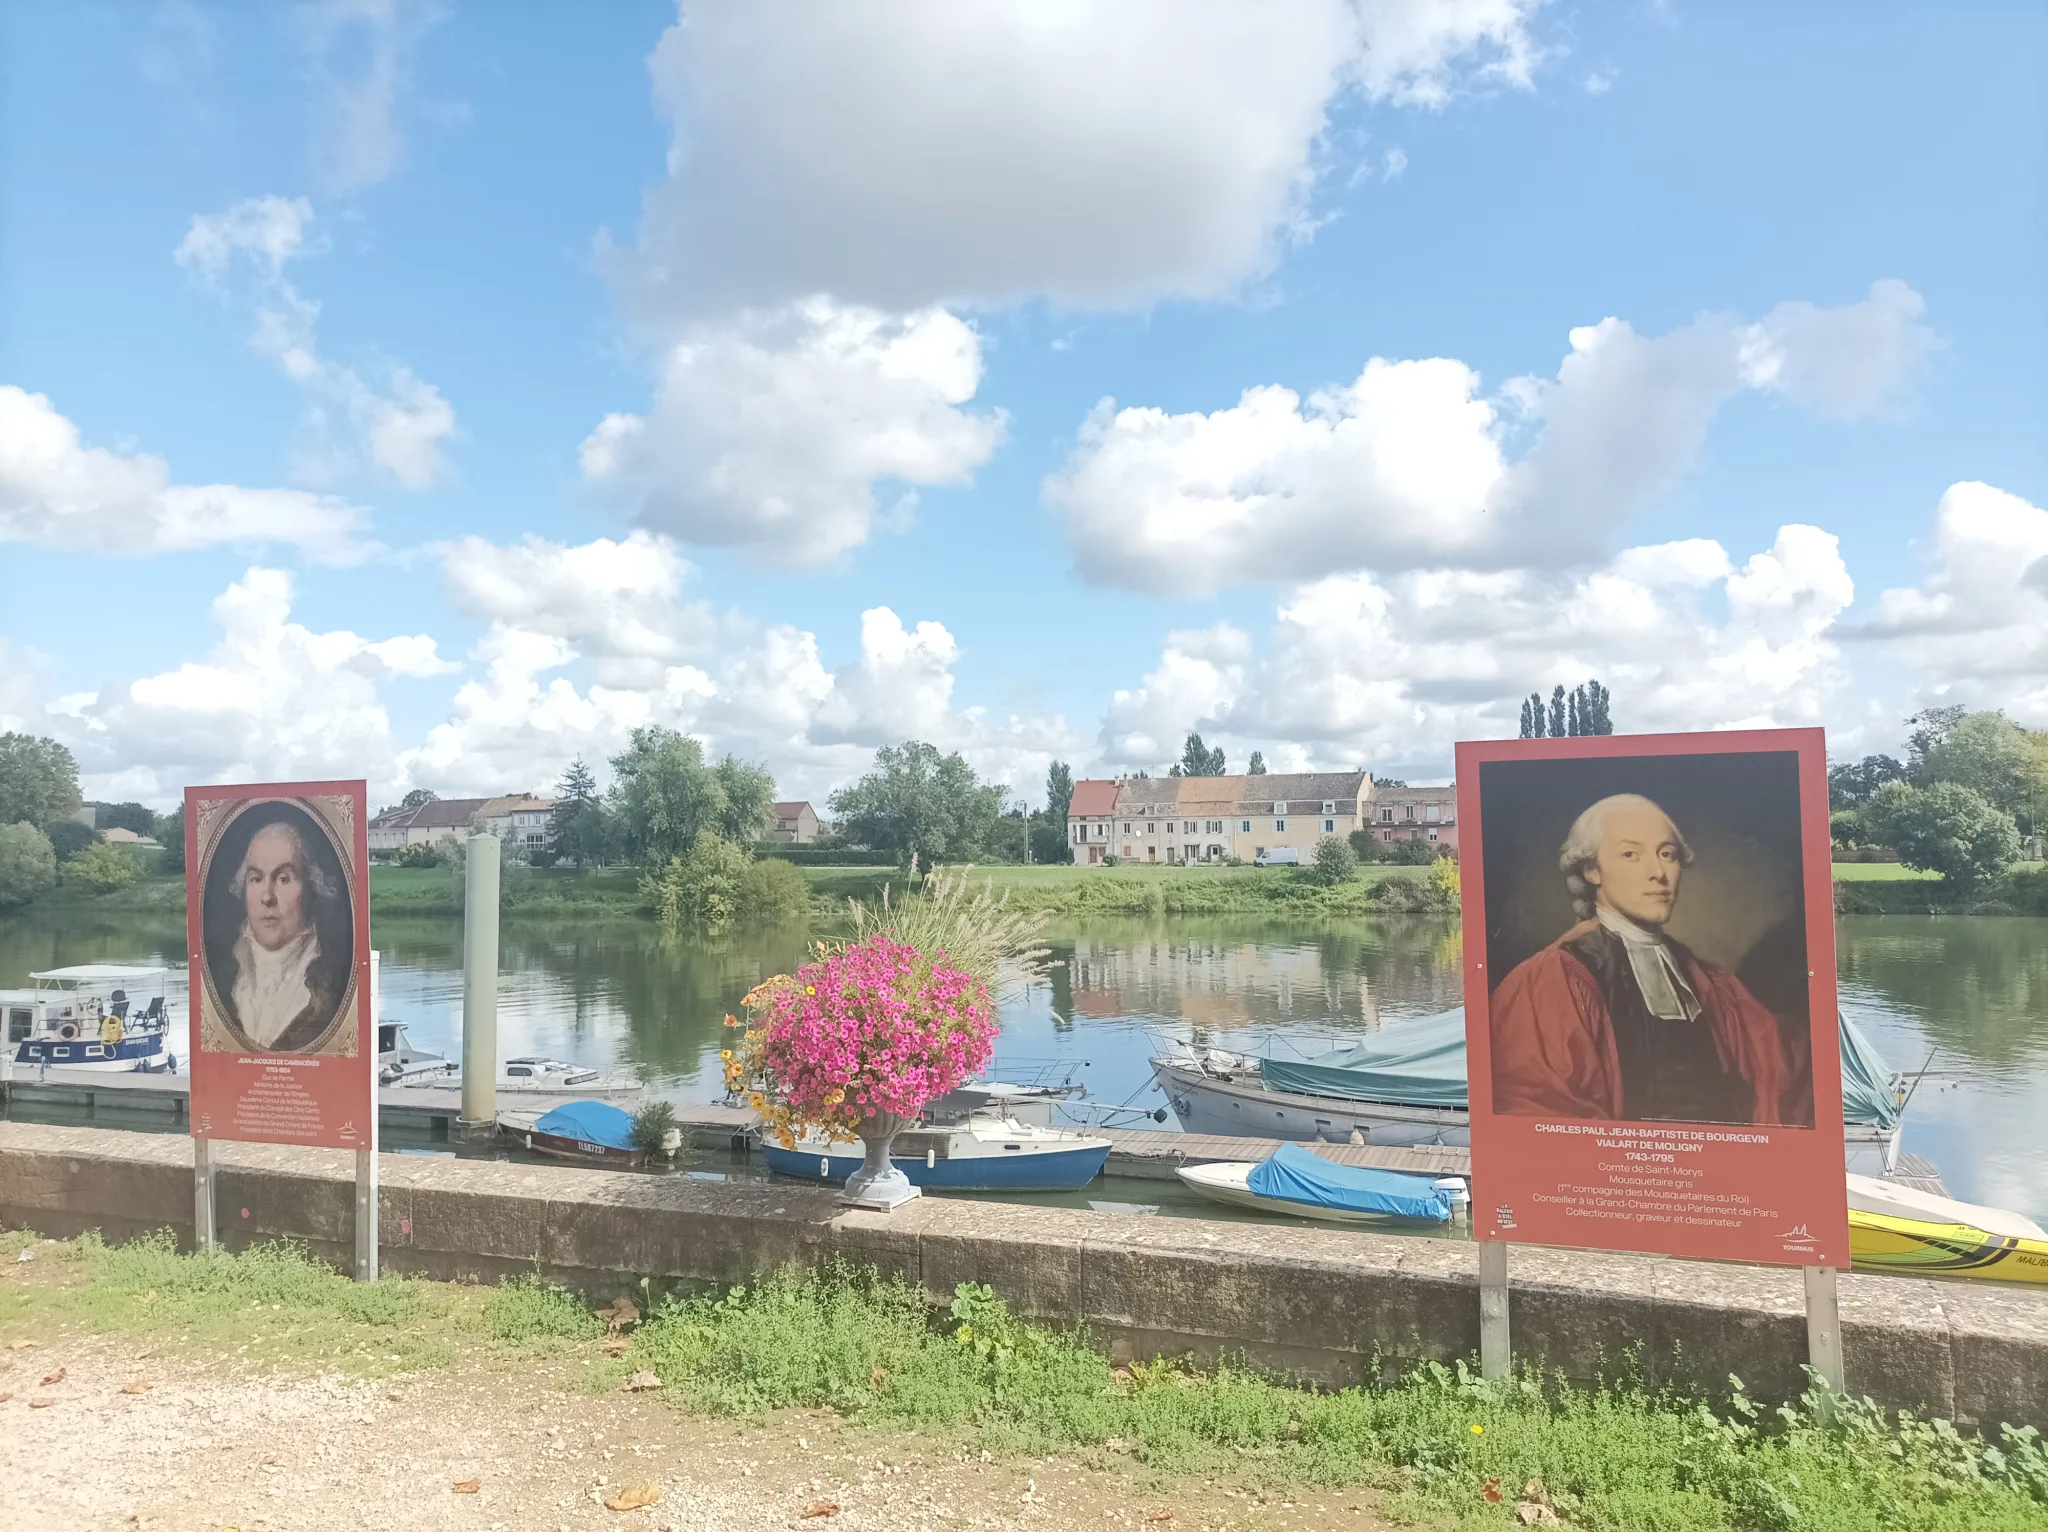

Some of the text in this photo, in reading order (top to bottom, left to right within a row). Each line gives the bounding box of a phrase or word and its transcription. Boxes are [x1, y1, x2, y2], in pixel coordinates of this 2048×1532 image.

[1535, 1124, 1768, 1144] CHARLES PAUL JEAN-BAPTISTE DE BOURGEVIN
[1596, 1139, 1703, 1152] VIALART DE MOLIGNY
[1625, 1152, 1674, 1162] 1743-1795
[1598, 1162, 1703, 1178] Comte de Saint-Morys
[1609, 1175, 1693, 1189] Mousquetaire gris
[1572, 1186, 1624, 1196] compagnie
[1626, 1188, 1642, 1196] des
[1644, 1189, 1714, 1202] Mousquetaires
[1716, 1194, 1729, 1202] du
[1730, 1194, 1750, 1204] Roi)
[1532, 1194, 1576, 1204] Conseiller
[1596, 1198, 1672, 1210] Grand-Chambre
[1674, 1203, 1686, 1212] du
[1688, 1204, 1736, 1215] Parlement
[1739, 1208, 1752, 1216] de
[1754, 1208, 1778, 1218] Paris
[1636, 1214, 1672, 1222] graveur
[1686, 1216, 1742, 1228] dessinateur
